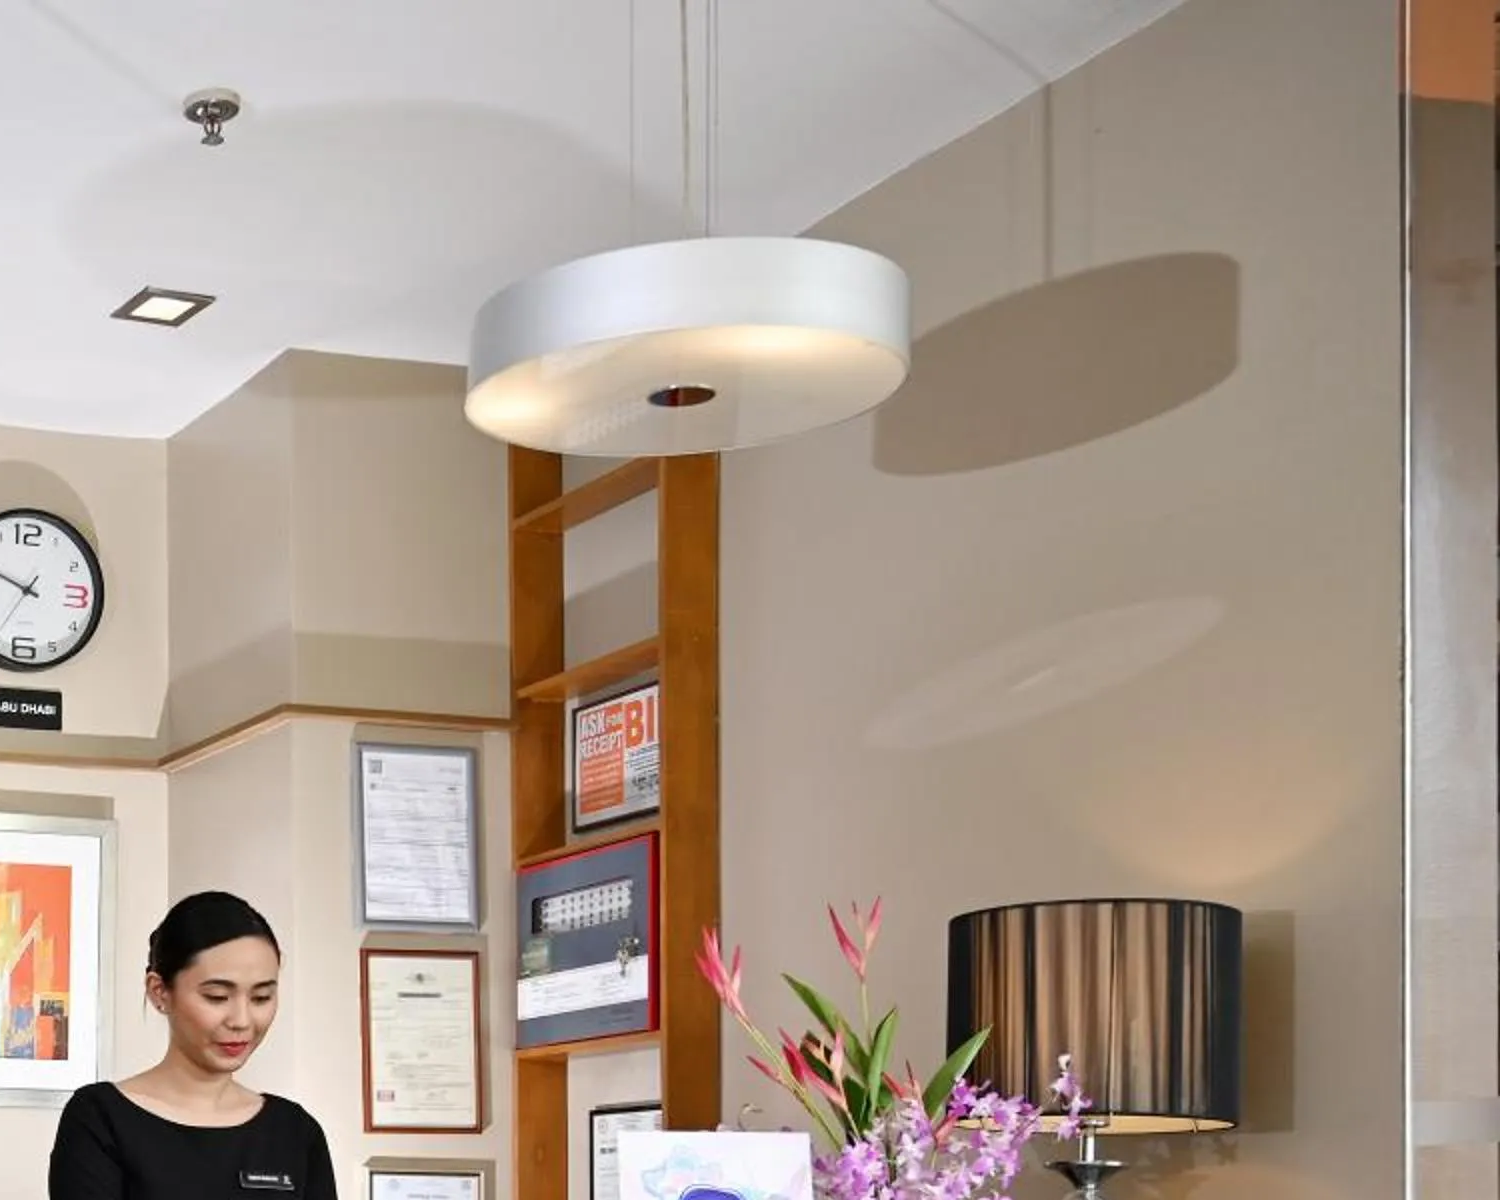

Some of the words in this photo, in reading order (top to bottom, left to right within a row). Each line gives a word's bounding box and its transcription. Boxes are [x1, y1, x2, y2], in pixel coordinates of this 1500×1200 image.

[14, 523, 42, 547] 12
[62, 584, 88, 609] 3
[11, 637, 36, 659] 6
[20, 702, 56, 715] DHABI
